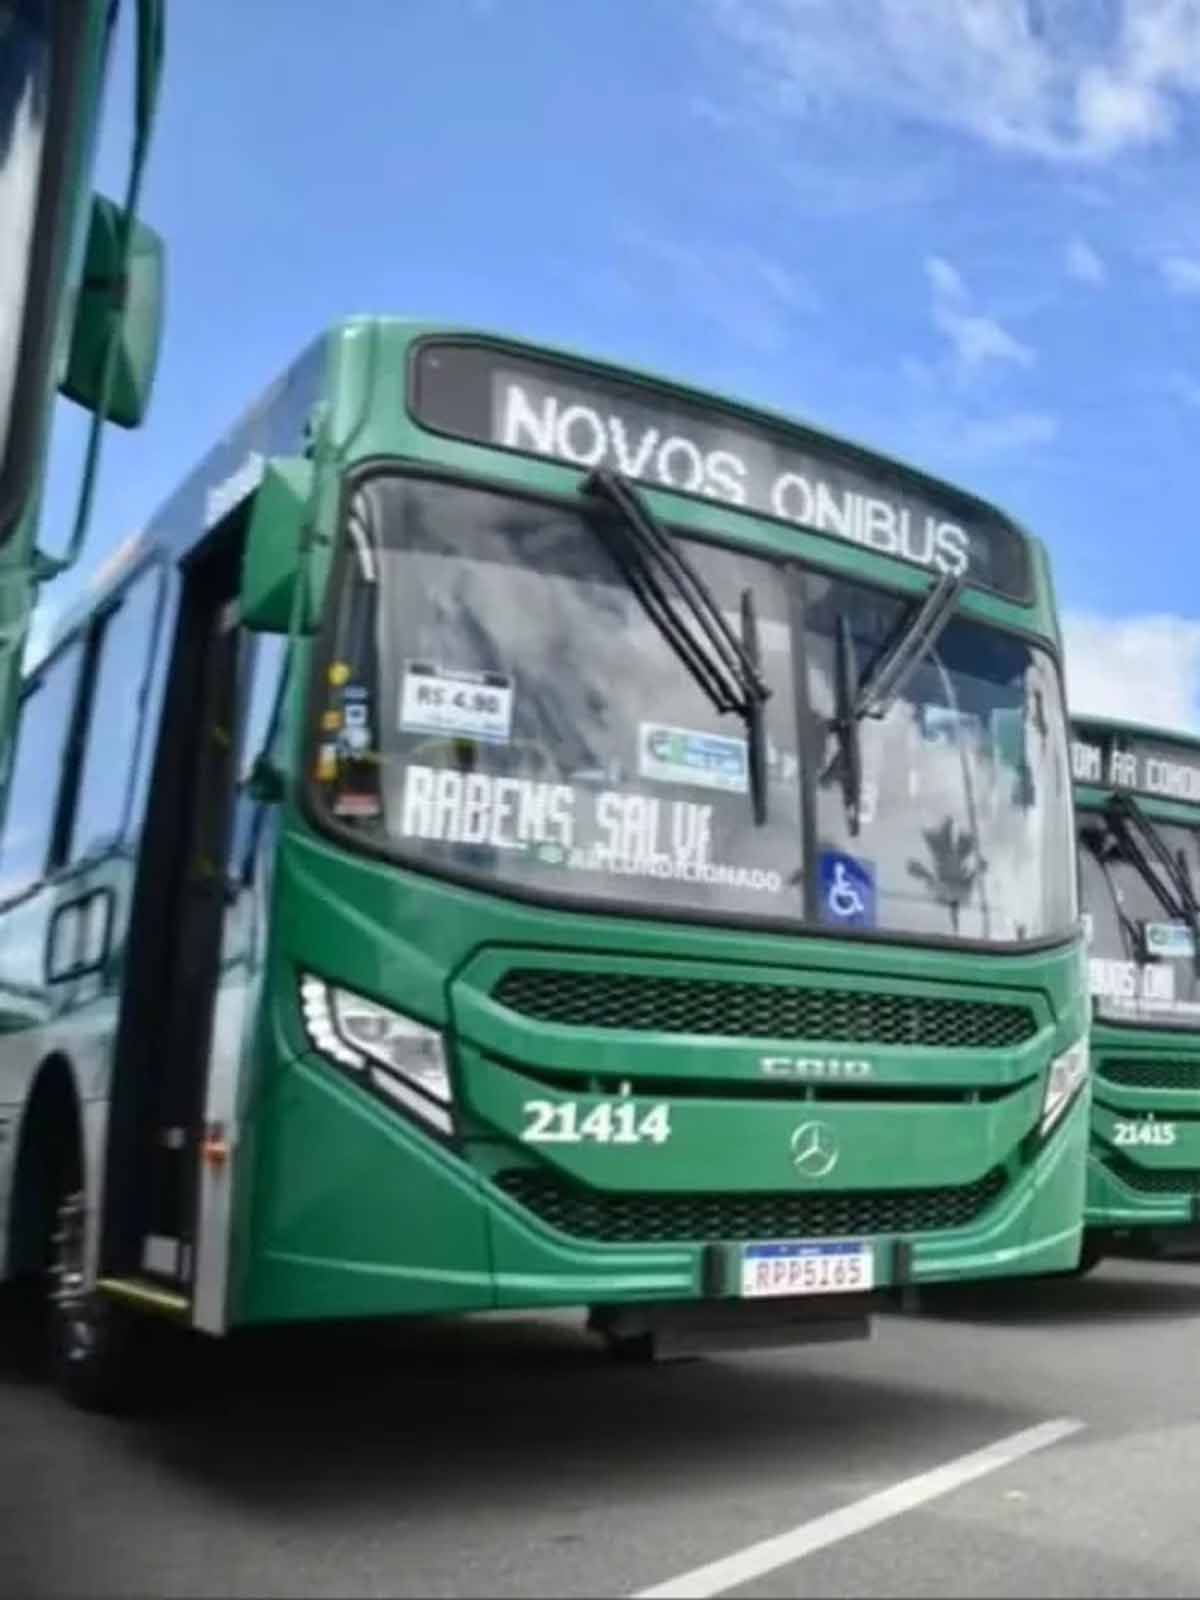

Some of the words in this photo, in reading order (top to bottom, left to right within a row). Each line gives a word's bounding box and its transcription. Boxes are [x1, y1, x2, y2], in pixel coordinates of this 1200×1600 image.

[502, 384, 748, 506] NOVOS
[771, 470, 970, 577] ONIBUS
[519, 1100, 671, 1144] 21414
[1113, 1122, 1175, 1145] 21415
